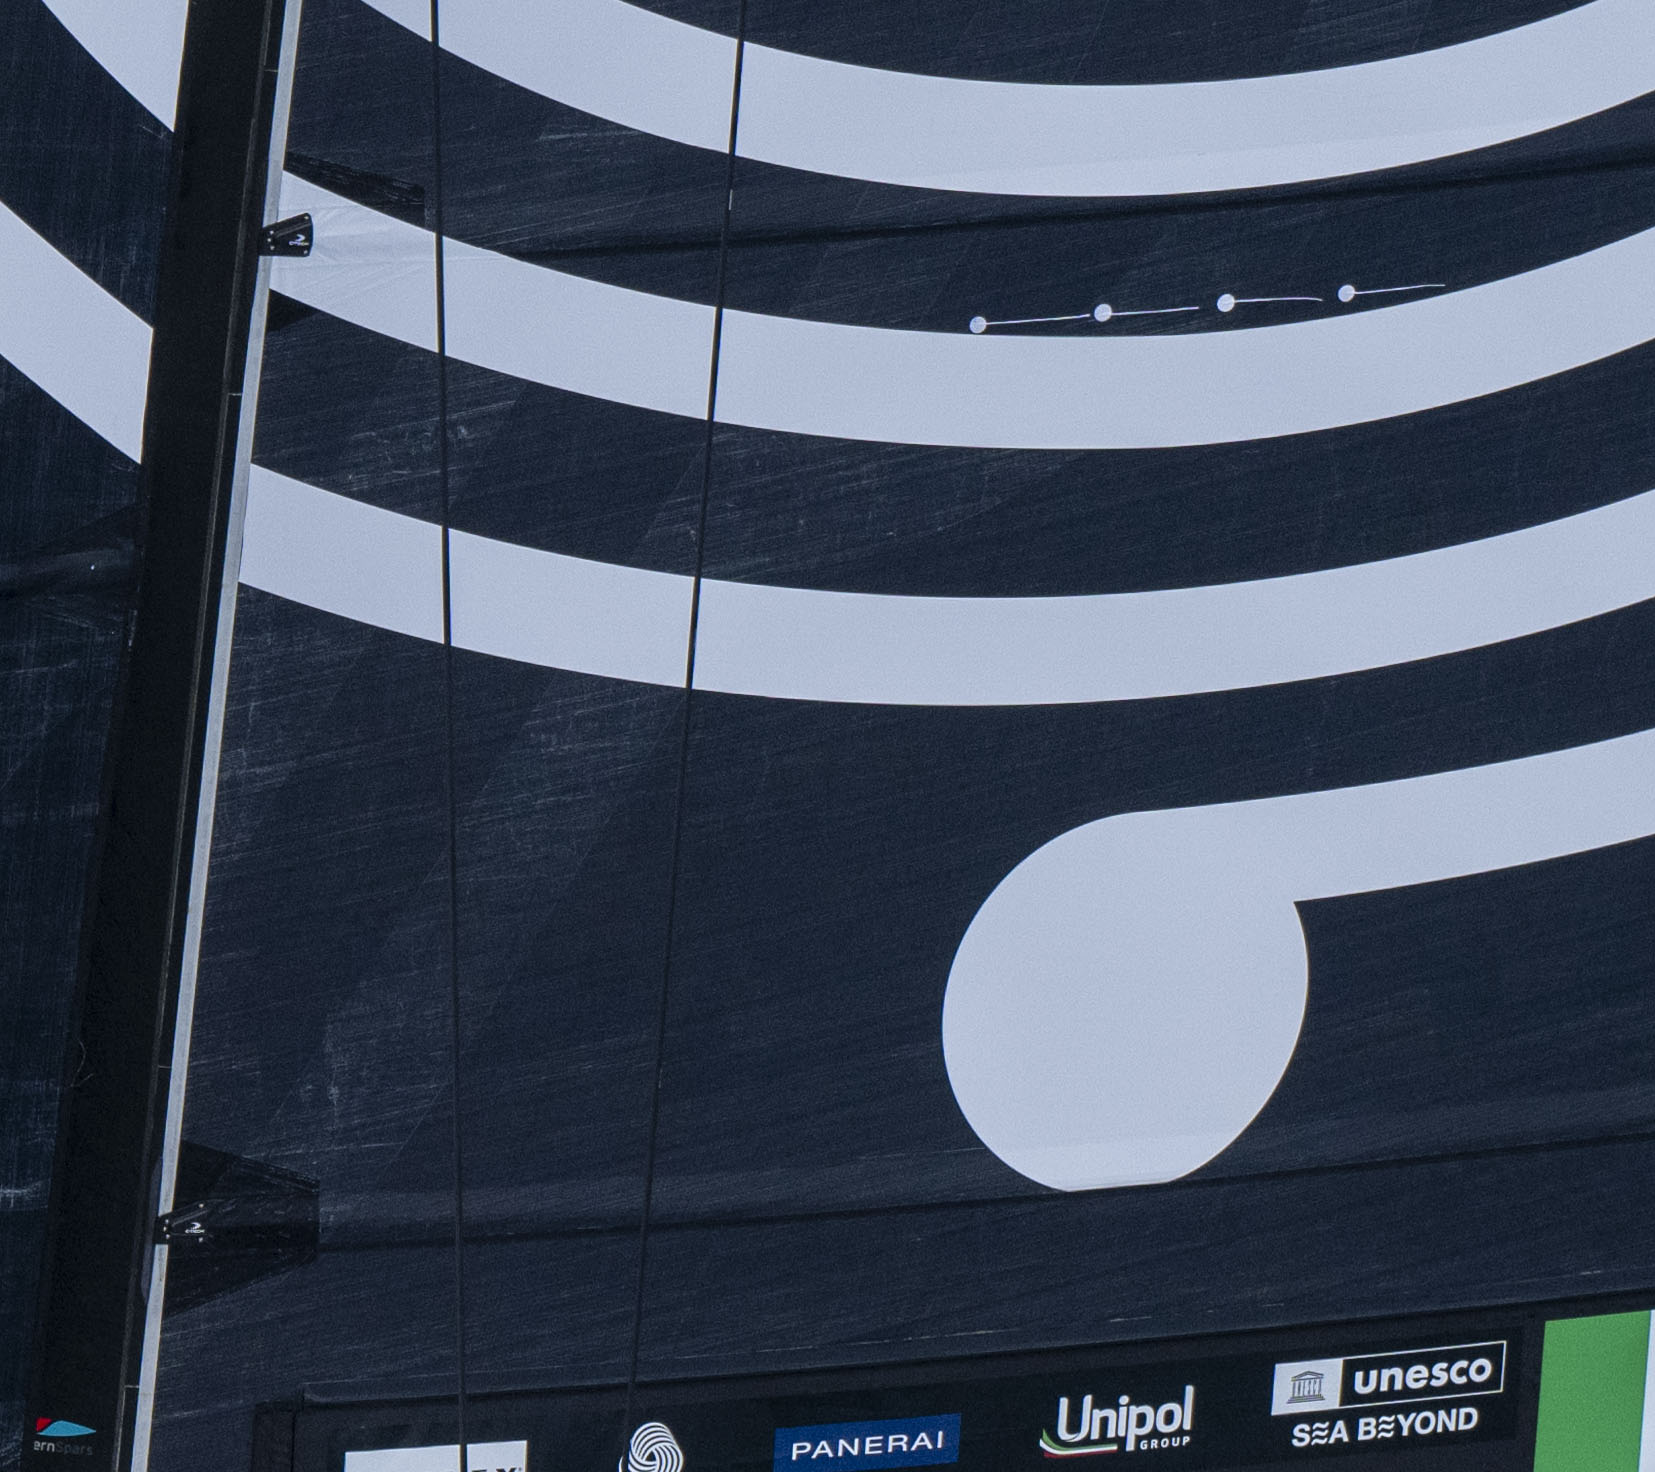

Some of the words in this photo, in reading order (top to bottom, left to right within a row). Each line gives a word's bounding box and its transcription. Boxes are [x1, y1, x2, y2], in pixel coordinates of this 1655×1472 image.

[1354, 1357, 1493, 1395] unesco
[1057, 1385, 1195, 1452] Unipol
[791, 1430, 945, 1461] PANERAI
[1139, 1435, 1192, 1451] GROUP
